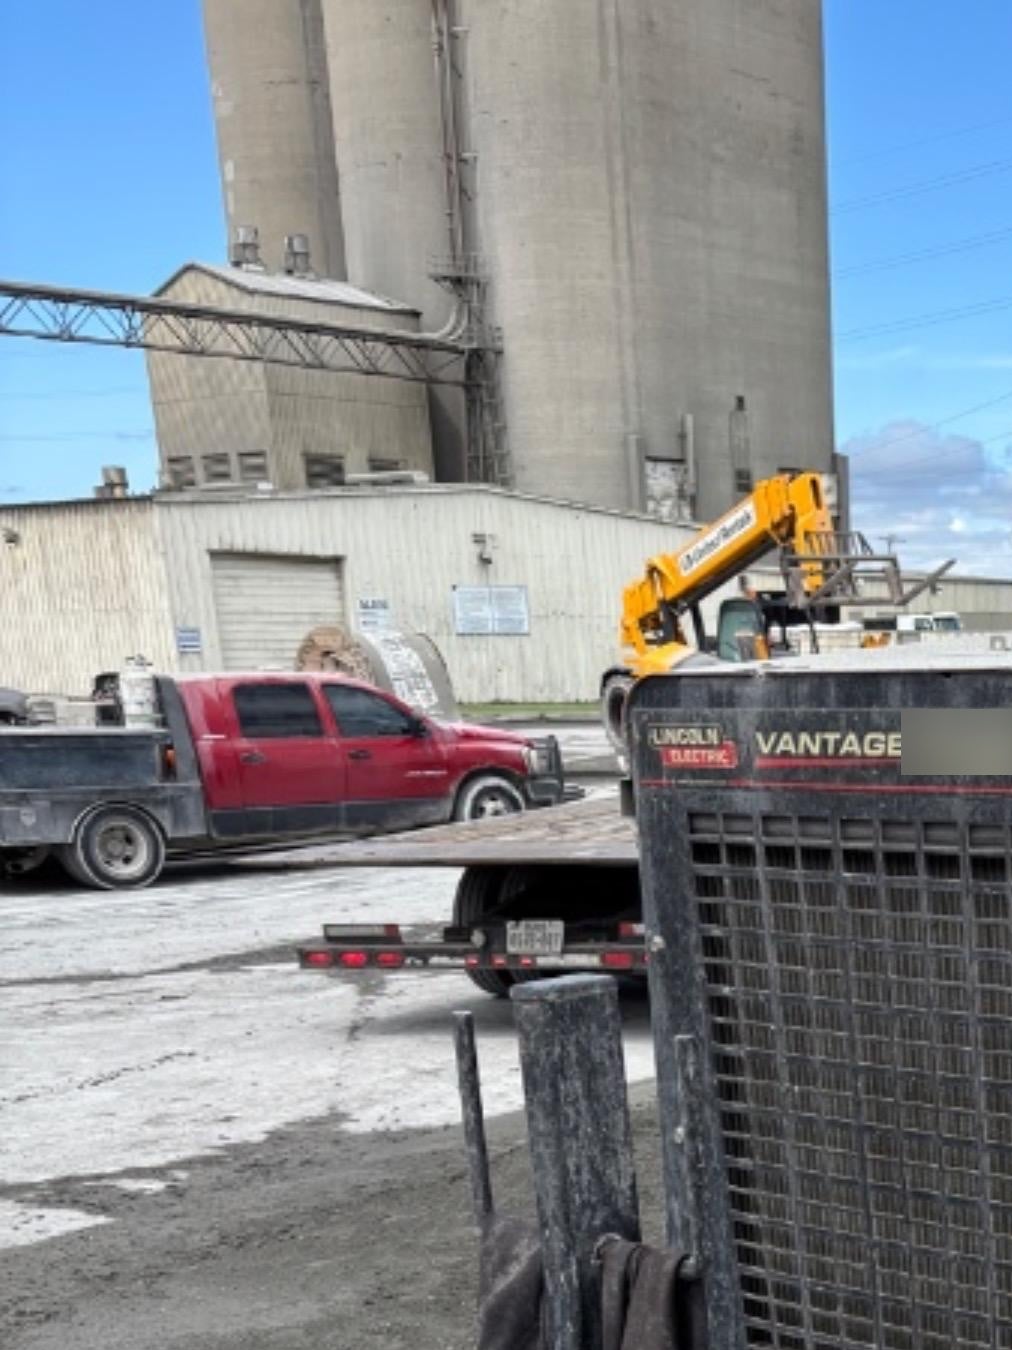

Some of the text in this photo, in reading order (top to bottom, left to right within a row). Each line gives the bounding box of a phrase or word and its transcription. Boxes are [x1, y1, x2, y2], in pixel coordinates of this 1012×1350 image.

[653, 727, 718, 746] LINCOLN
[756, 731, 902, 757] VANTAGE
[670, 749, 730, 764] ELECTRIC
